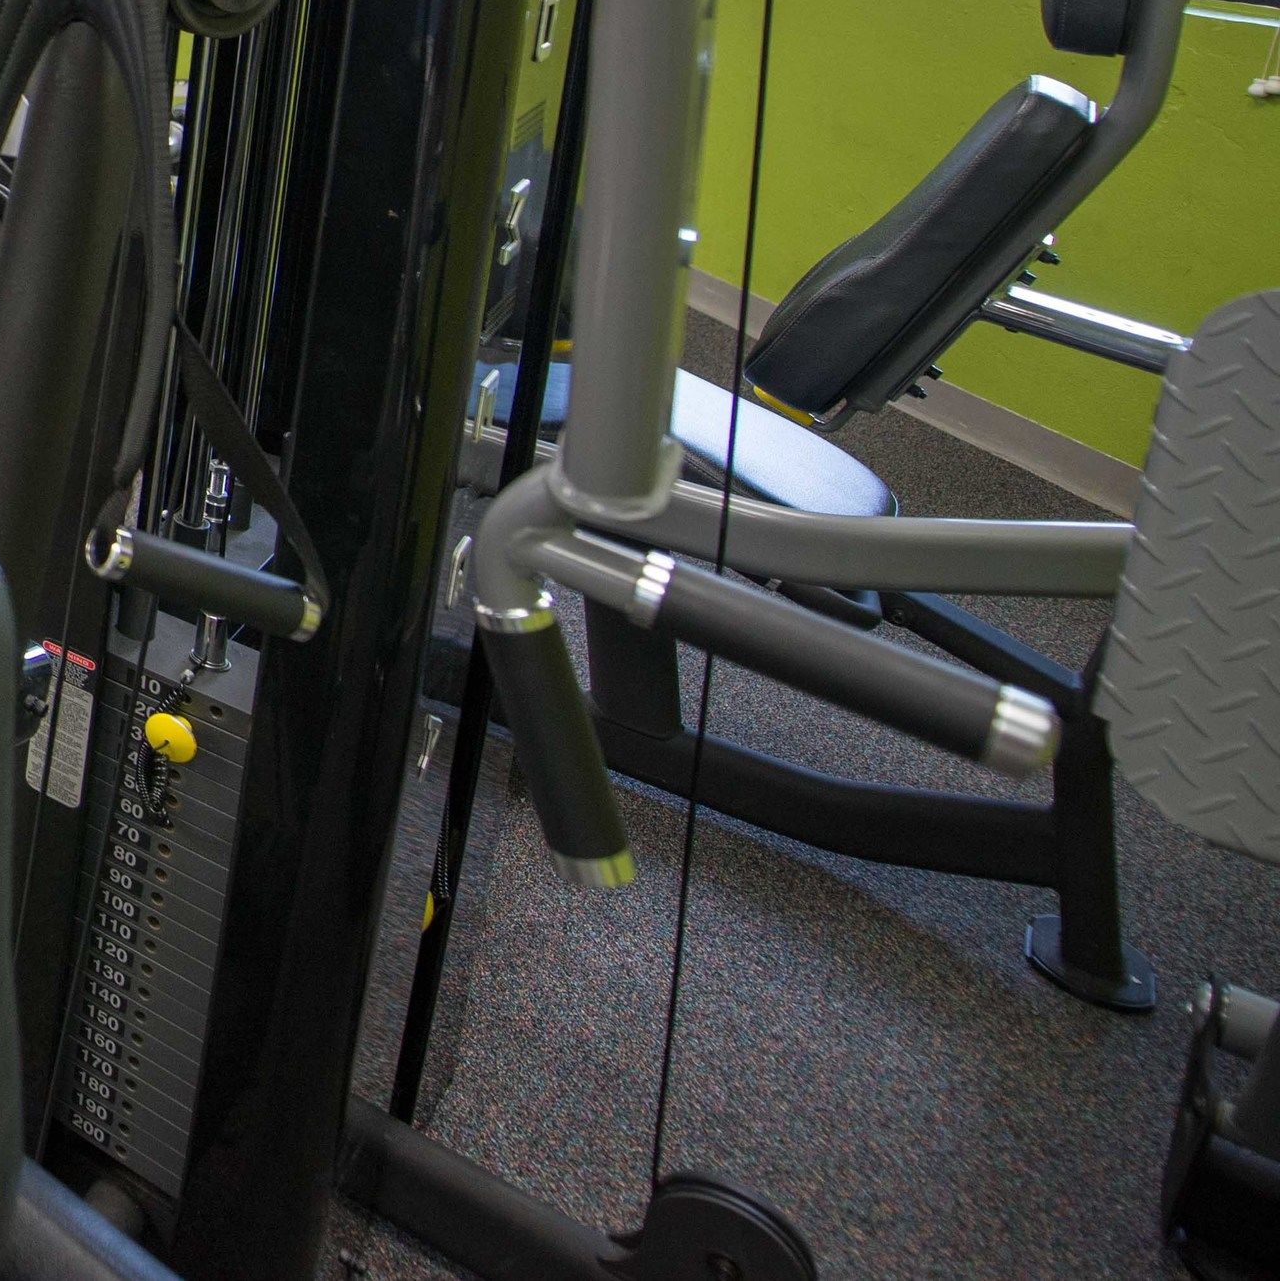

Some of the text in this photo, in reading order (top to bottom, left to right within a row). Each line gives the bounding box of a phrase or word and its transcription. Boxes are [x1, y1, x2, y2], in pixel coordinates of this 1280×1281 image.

[48, 644, 90, 667] WANING
[140, 675, 161, 695] 10
[120, 798, 144, 819] 60
[117, 820, 140, 843] 70
[113, 845, 137, 867] 80
[109, 868, 132, 890] 90
[102, 890, 135, 917] 100
[99, 913, 131, 939] 110
[96, 936, 128, 963] 120
[93, 959, 125, 986] 130
[89, 981, 121, 1009] 140
[87, 1004, 119, 1032] 150
[85, 1026, 117, 1055] 160
[81, 1048, 113, 1077] 170
[79, 1071, 110, 1099] 180
[76, 1092, 107, 1120] 190
[72, 1113, 105, 1143] 200
